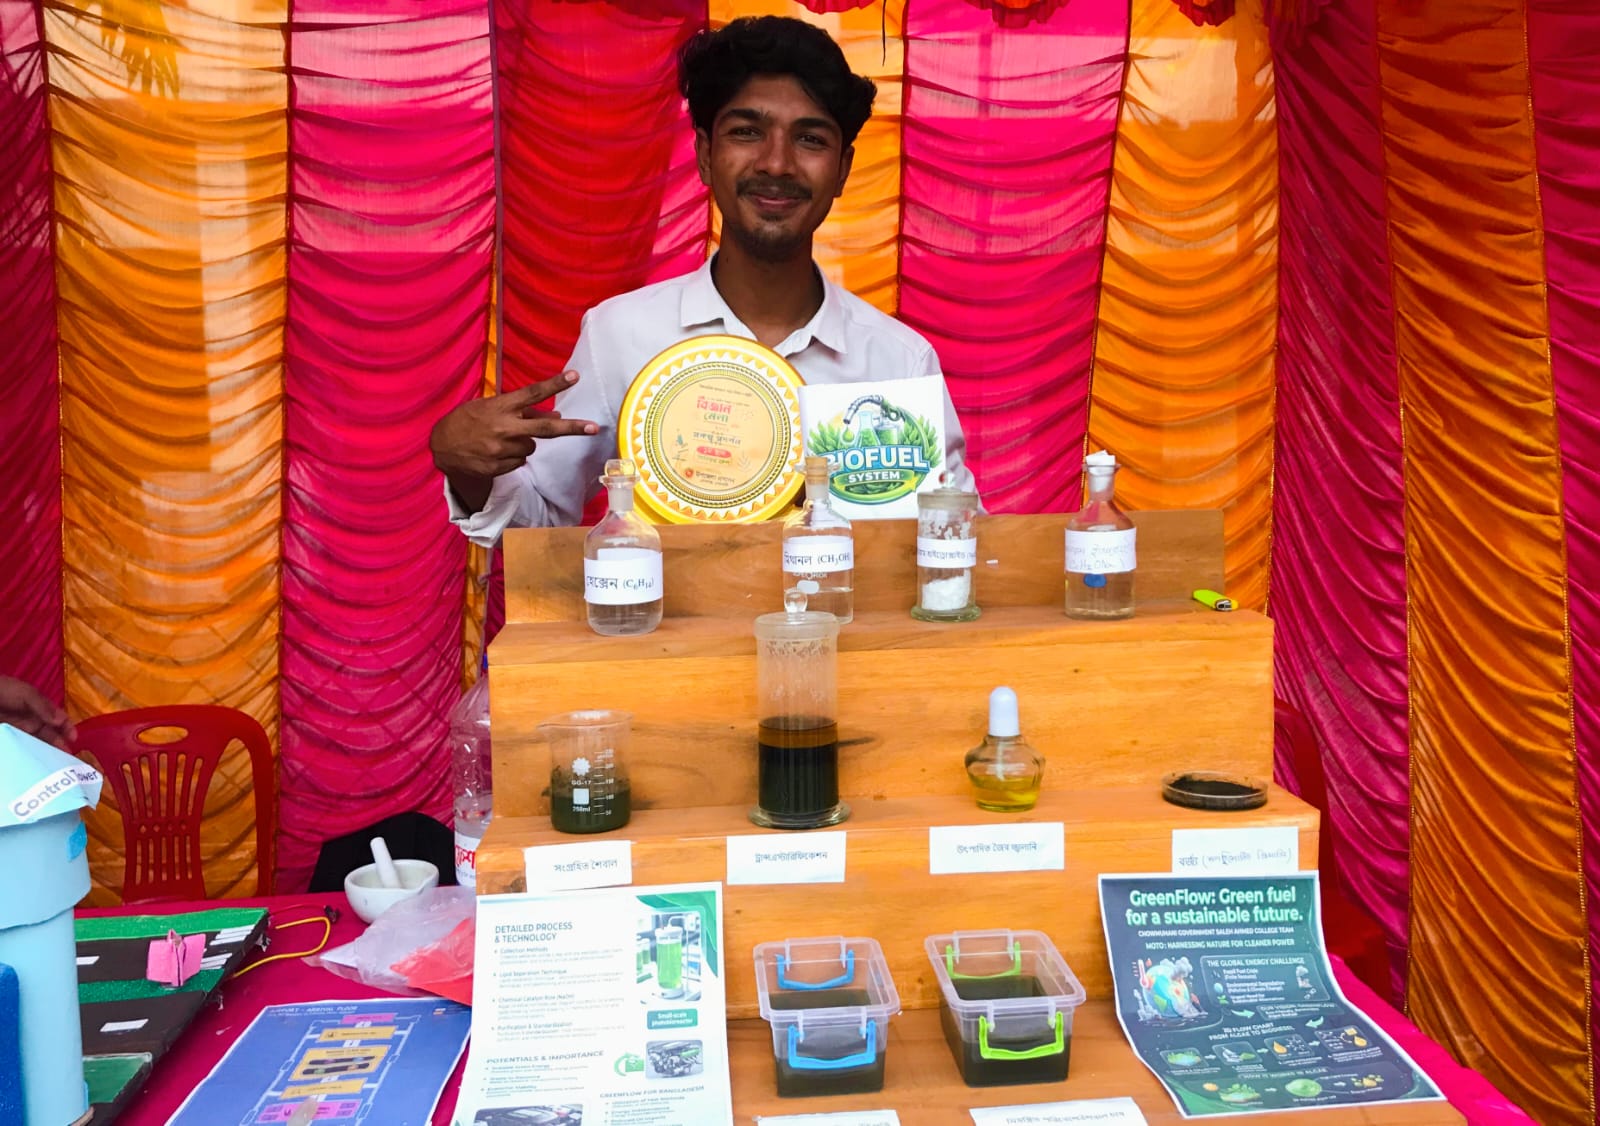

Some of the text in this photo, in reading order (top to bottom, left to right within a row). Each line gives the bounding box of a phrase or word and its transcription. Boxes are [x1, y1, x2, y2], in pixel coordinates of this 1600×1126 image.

[848, 471, 900, 483] SYSTEM
[14, 771, 76, 816] Control
[1129, 886, 1296, 907] GreenFlow: Green fuel
[1125, 905, 1304, 926] for a sustainable future.
[495, 921, 573, 934] DETAILED PROCESS
[502, 933, 557, 943] TECHNOLOGY
[1167, 941, 1205, 949] HARNESSING
[1206, 940, 1231, 948] NATURE
[1244, 939, 1271, 947] CLEANER
[1272, 938, 1295, 946] POWER
[1245, 958, 1269, 966] ENERGY
[1269, 957, 1305, 965] CHALLENGE
[1252, 1022, 1274, 1030] CHART
[486, 1055, 539, 1063] POTENTIALS
[549, 1050, 604, 1061] IMPORTANCE
